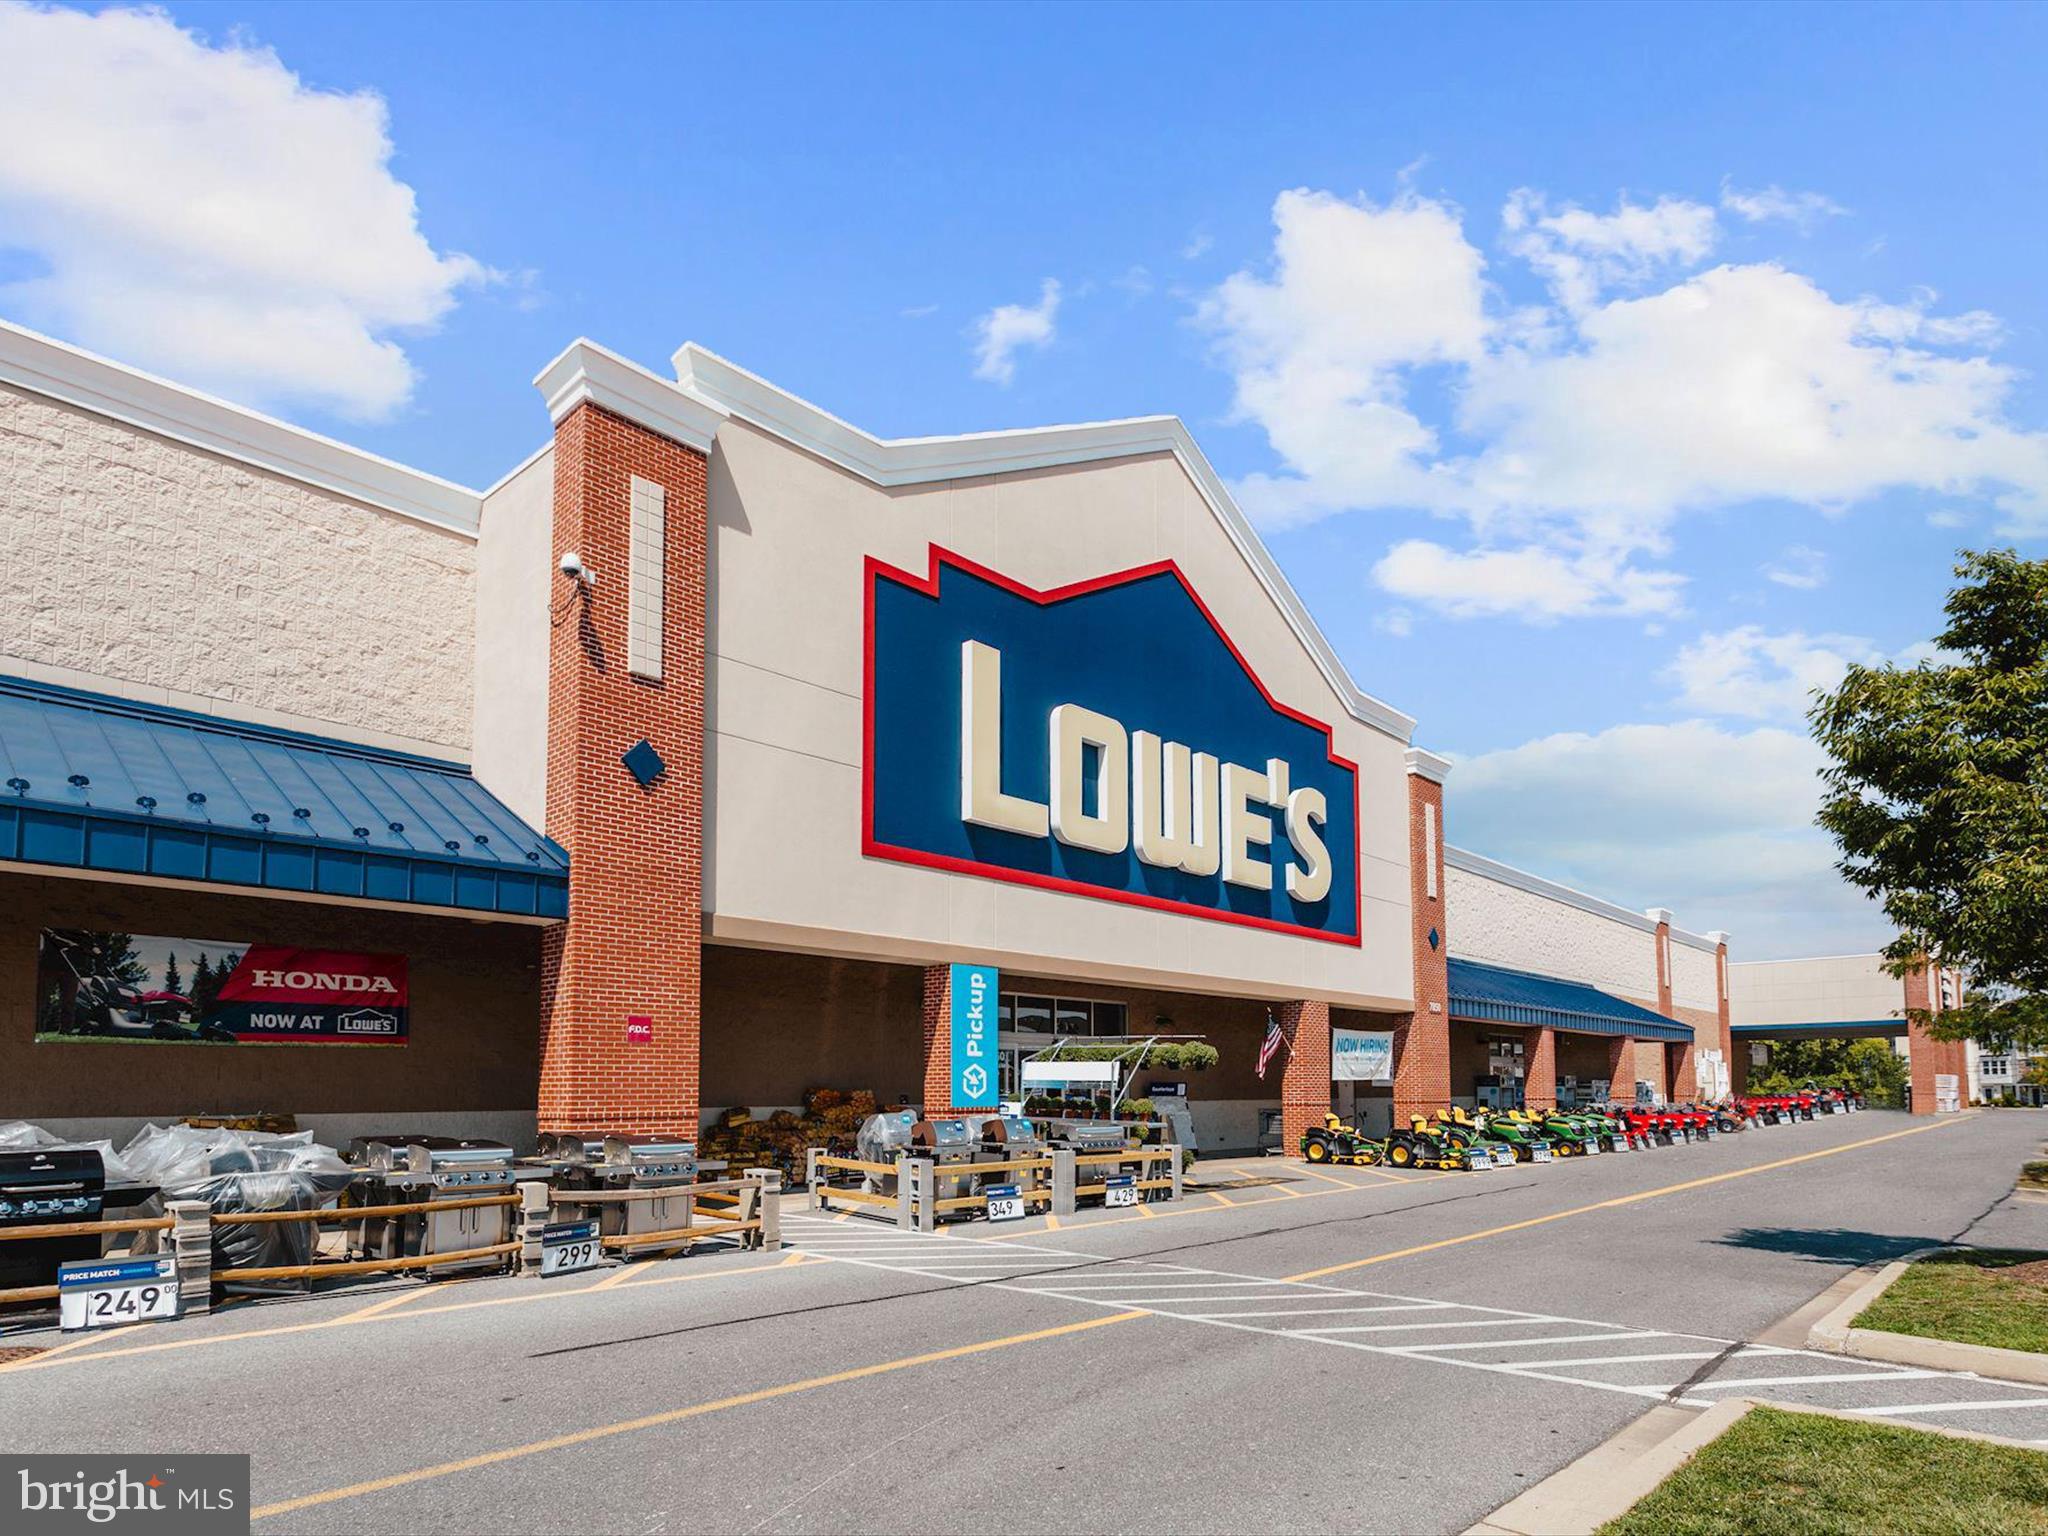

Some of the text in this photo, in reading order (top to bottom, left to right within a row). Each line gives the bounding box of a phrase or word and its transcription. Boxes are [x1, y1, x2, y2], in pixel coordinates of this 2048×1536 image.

[961, 640, 1332, 903] LOWE'S
[252, 969, 398, 993] HONDA
[250, 1014, 324, 1030] NOW AT
[966, 973, 987, 1057] Pickup
[344, 1017, 392, 1031] LOWE'S
[1335, 1038, 1389, 1055] NOW HIRING
[1114, 1188, 1134, 1203] 429
[990, 1200, 1013, 1217] 349
[558, 1243, 592, 1268] 299
[63, 1273, 89, 1281] PRICE
[90, 1269, 120, 1279] MATCH
[94, 1287, 160, 1316] 249
[164, 1284, 177, 1294] 00
